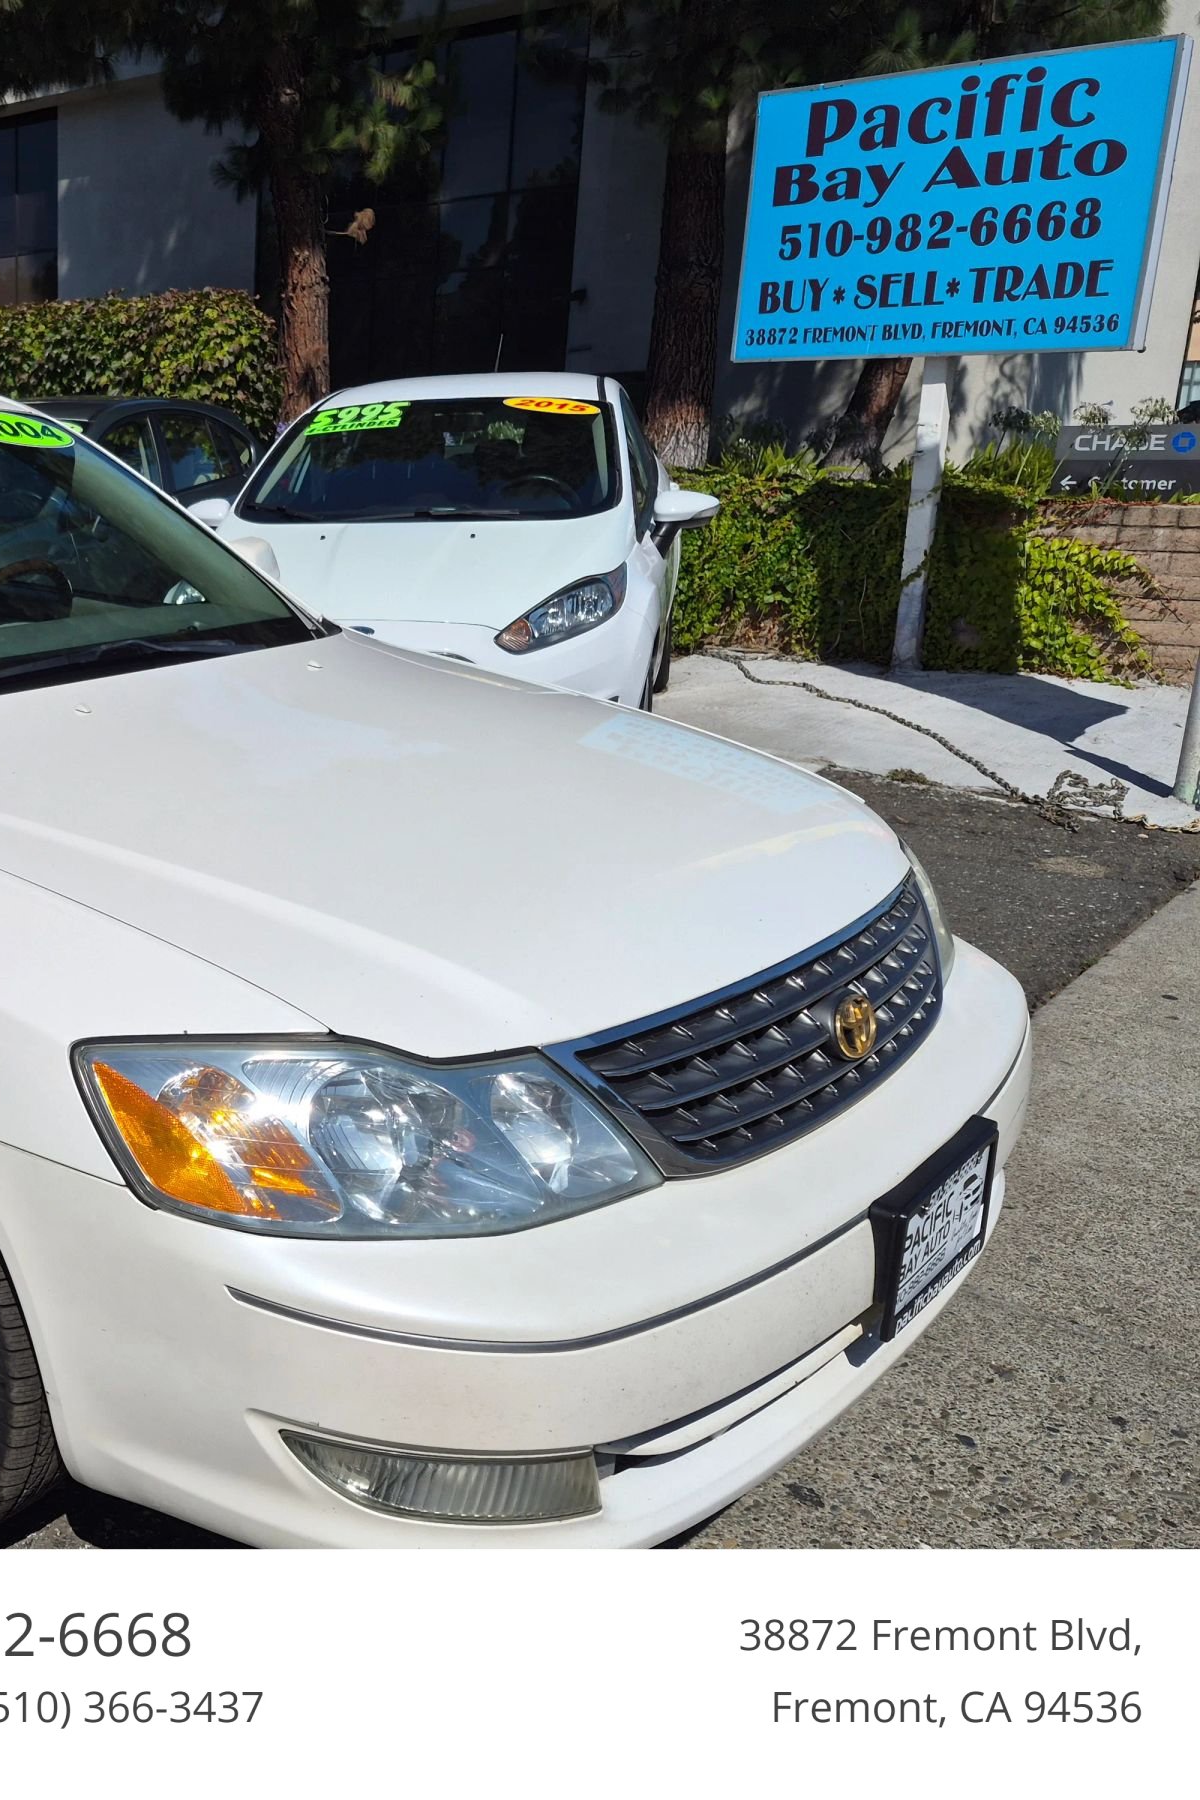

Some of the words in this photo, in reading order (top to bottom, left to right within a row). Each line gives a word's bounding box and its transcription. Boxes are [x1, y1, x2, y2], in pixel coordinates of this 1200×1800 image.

[805, 66, 1101, 158] Pacific
[772, 162, 906, 208] Bay
[922, 134, 1127, 192] Auto
[778, 198, 1102, 260] 510-982-6668
[758, 278, 830, 314] BUY
[853, 270, 944, 310] SELL
[969, 259, 1114, 303] TRADE
[745, 328, 798, 347] 38872
[803, 323, 878, 344] FREMONT
[881, 320, 926, 342] BLVD,
[931, 317, 1018, 339] FREMONT,
[1023, 317, 1048, 335] CA
[1053, 314, 1120, 334] 94536
[310, 401, 411, 428] 5995
[514, 399, 589, 412] 2015
[900, 1249, 921, 1282] BAY
[922, 1221, 950, 1262] AUTO
[904, 1191, 954, 1255] PACIFIC
